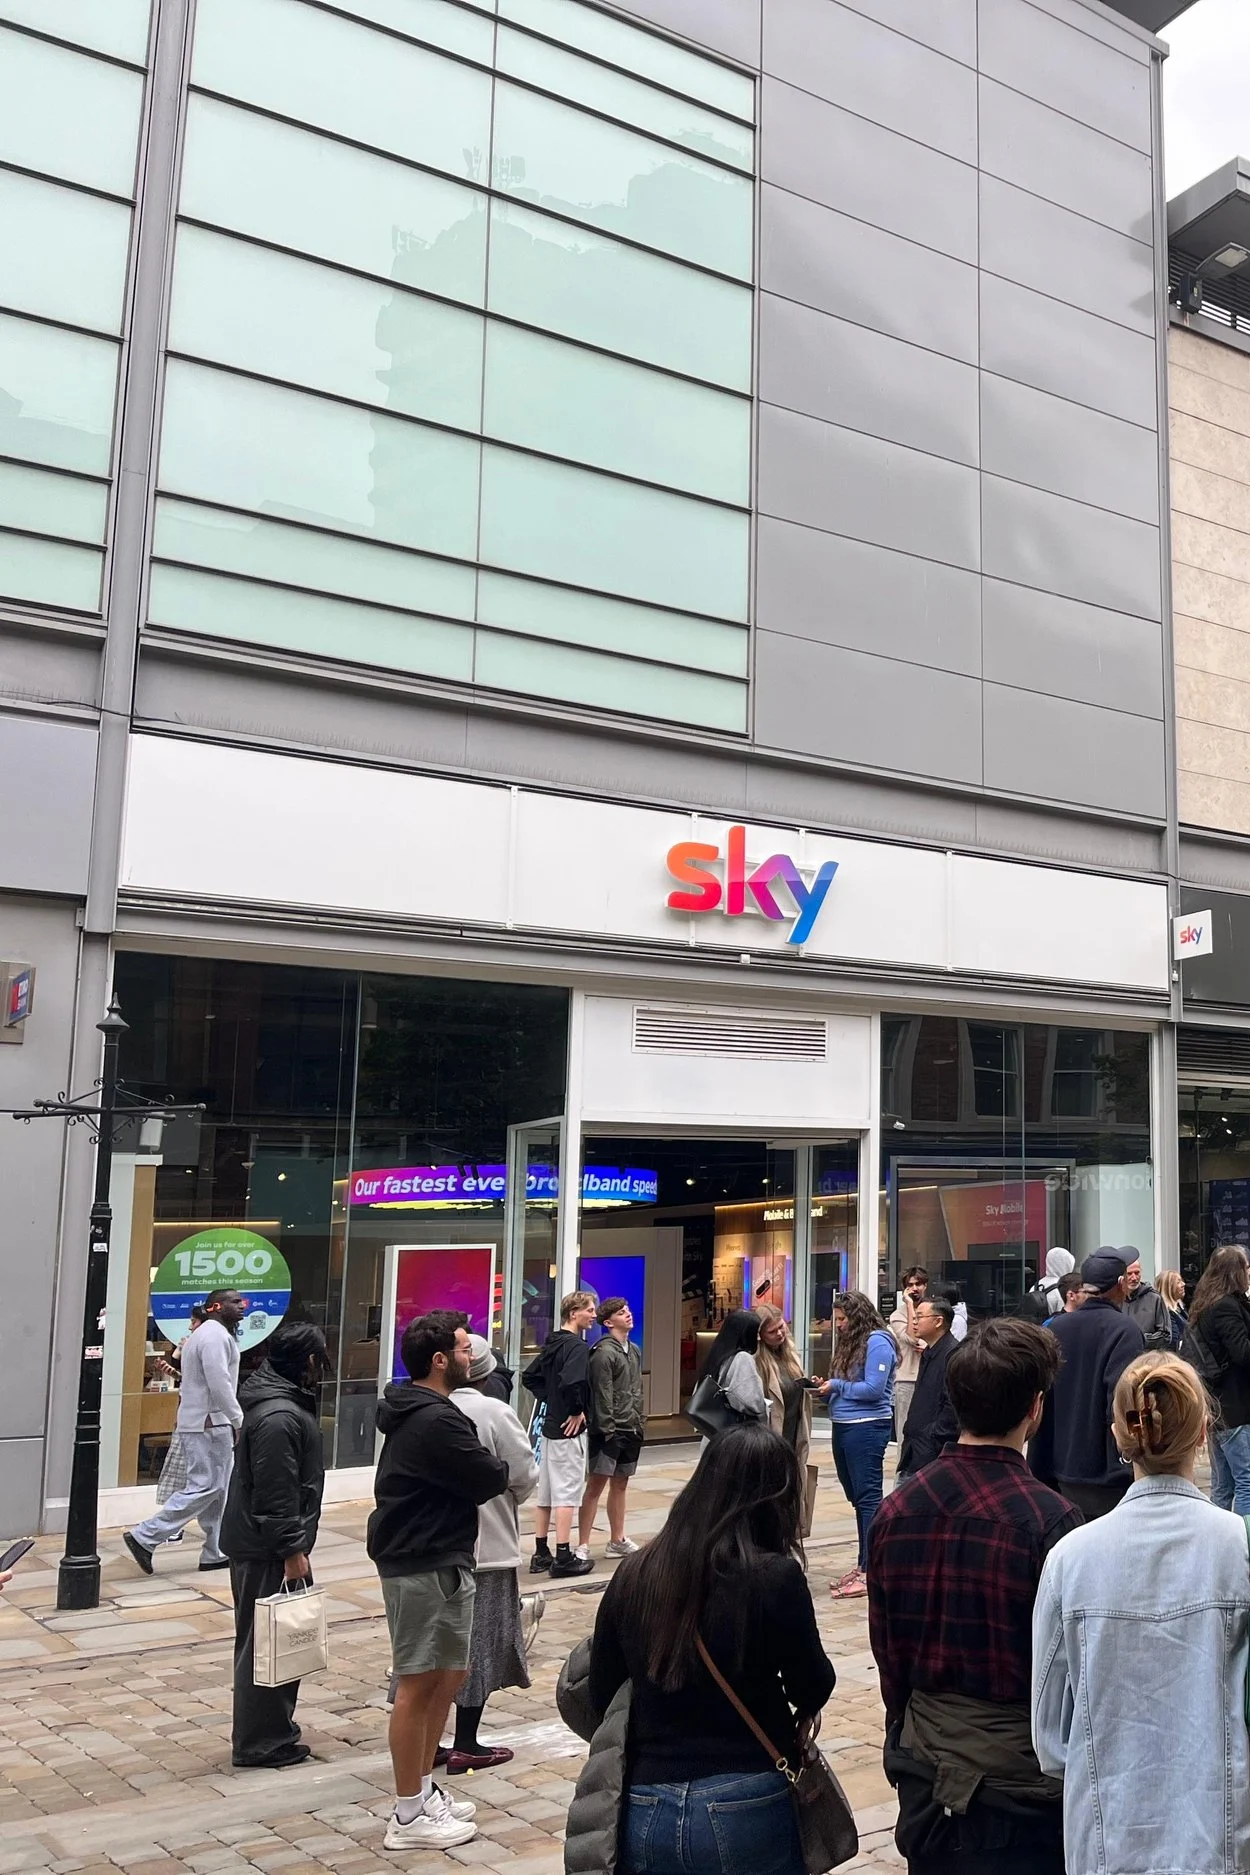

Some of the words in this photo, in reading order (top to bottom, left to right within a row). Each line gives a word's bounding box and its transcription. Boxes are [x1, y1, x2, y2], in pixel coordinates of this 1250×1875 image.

[666, 825, 839, 944] sky
[1180, 925, 1204, 945] sky
[355, 1178, 380, 1197] Our
[383, 1174, 456, 1194] fastest
[462, 1174, 505, 1193] eve
[526, 1174, 630, 1194] broband
[195, 1241, 212, 1249] Join
[174, 1249, 272, 1277] 1500
